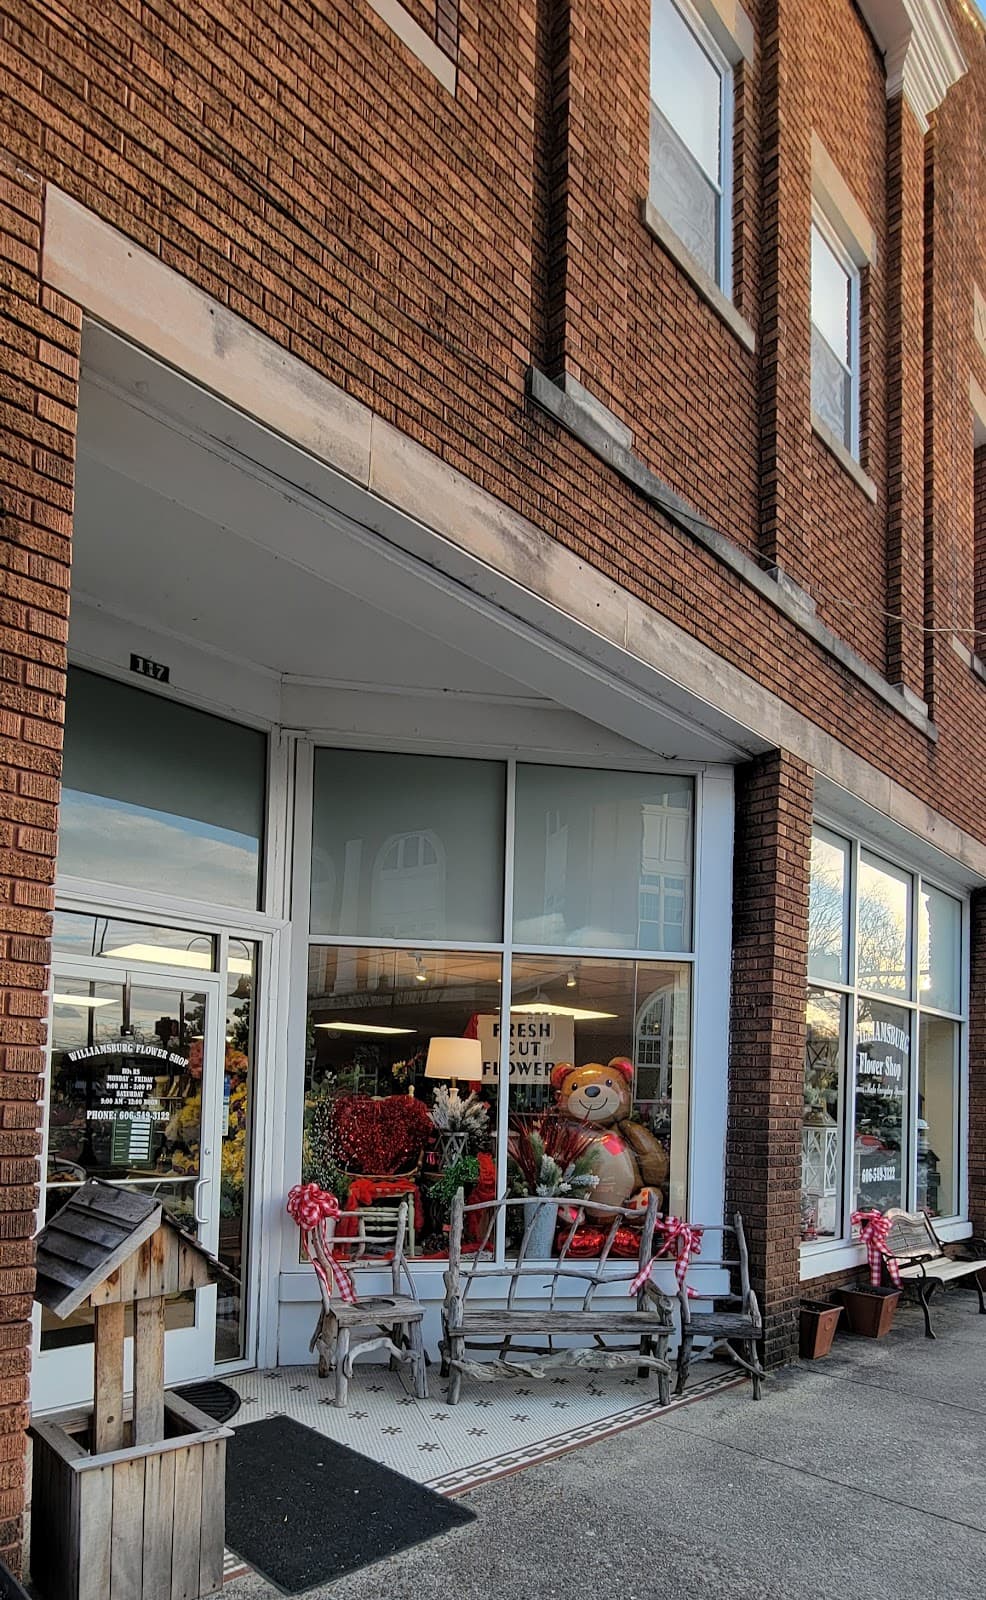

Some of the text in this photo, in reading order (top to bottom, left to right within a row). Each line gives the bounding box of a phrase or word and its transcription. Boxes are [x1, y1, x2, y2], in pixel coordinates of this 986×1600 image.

[136, 657, 165, 679] 117
[493, 1023, 551, 1037] FRESH
[858, 1021, 909, 1055] ILLIAMSBURG
[68, 1043, 189, 1067] WILLIAMSBURG FLOWER SHOP
[508, 1041, 541, 1056] CUT
[482, 1061, 555, 1076] FLOWER
[858, 1052, 902, 1081] Flower Shop
[134, 1075, 154, 1083] FRIDAY
[86, 1110, 170, 1120] PHONE: 606-549-3122
